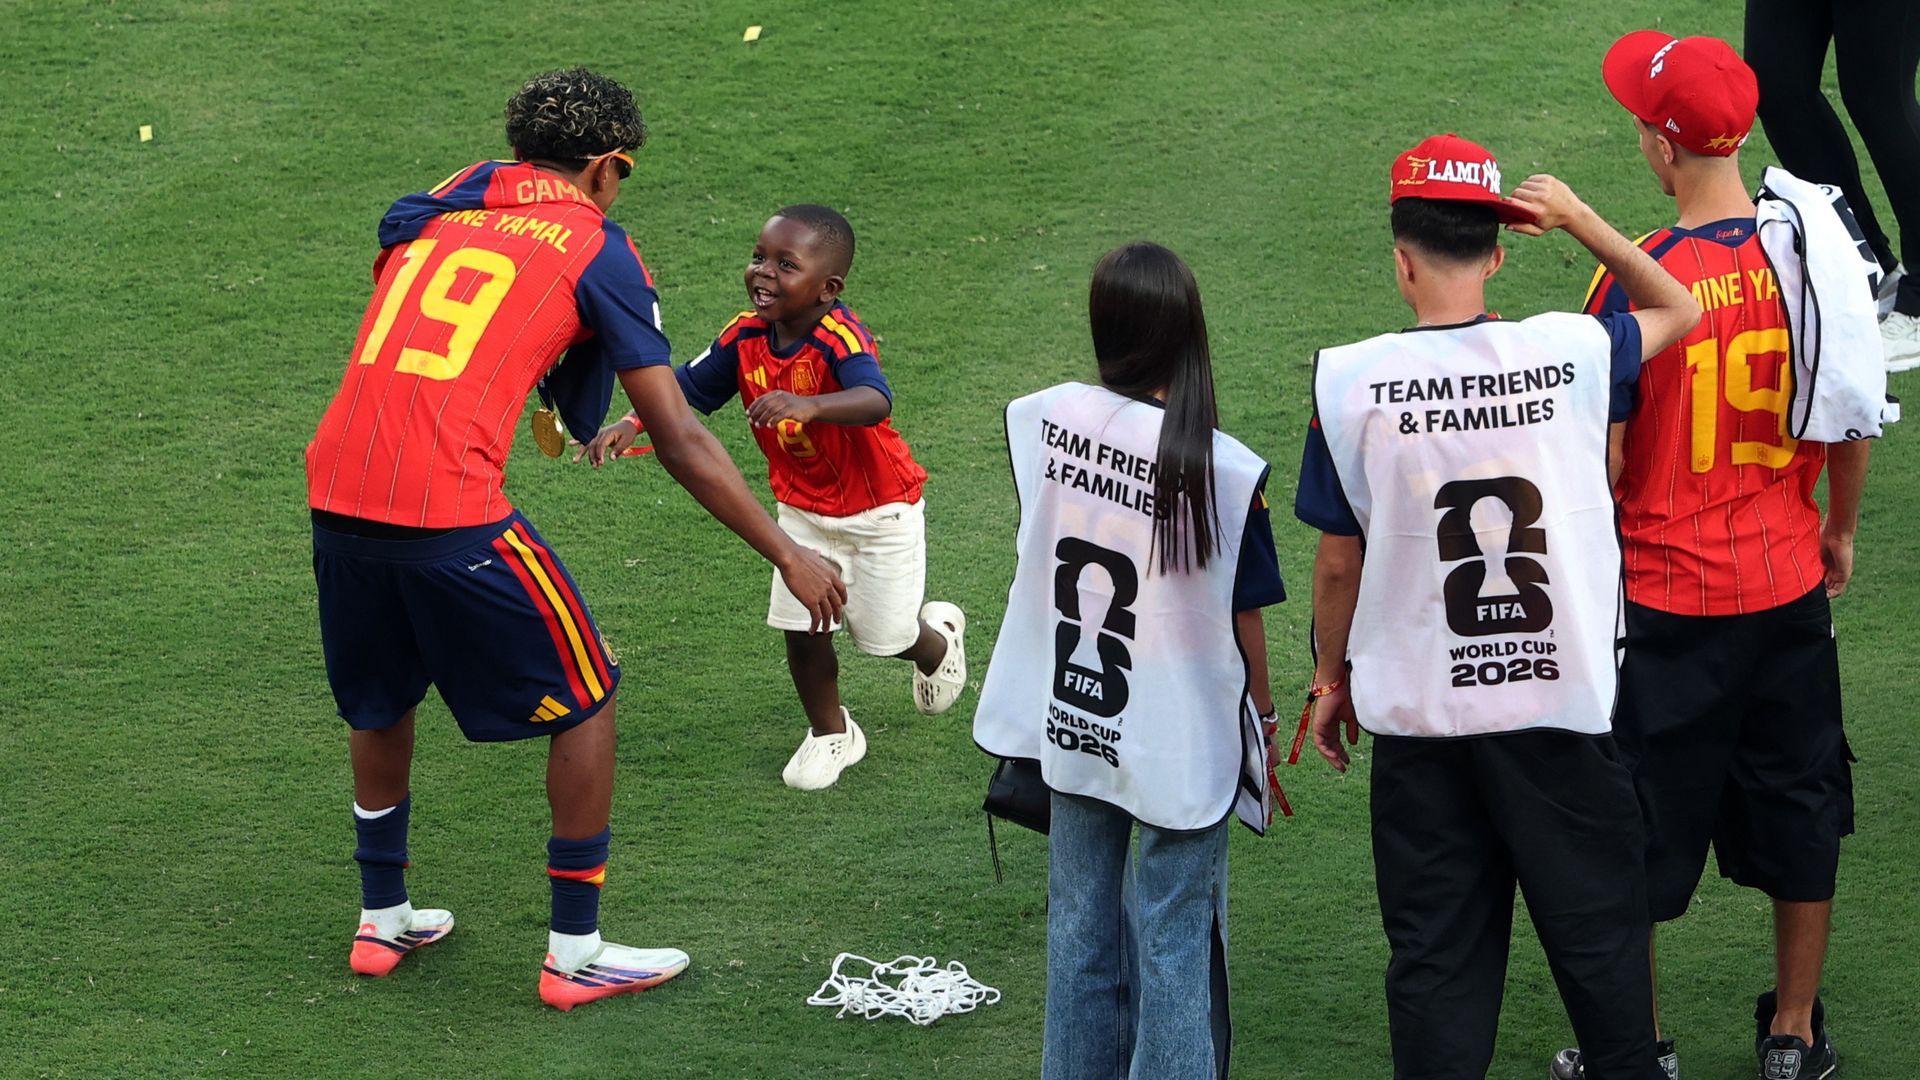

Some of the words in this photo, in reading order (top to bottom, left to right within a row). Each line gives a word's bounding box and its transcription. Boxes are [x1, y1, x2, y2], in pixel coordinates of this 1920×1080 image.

[494, 214, 573, 254] YAMAL
[358, 239, 516, 381] 19
[1370, 377, 1454, 404] TEAM
[1461, 362, 1575, 398] FRIENDS
[1686, 328, 1797, 474] 19
[1399, 411, 1420, 434] &
[1425, 398, 1554, 432] FAMILIES
[1041, 418, 1091, 461] TEAM
[1045, 457, 1057, 481] &
[1476, 602, 1527, 621] FIFA
[1449, 641, 1518, 661] WORLD
[1521, 640, 1557, 655] CUP
[1064, 670, 1103, 700] FIFA
[1450, 658, 1560, 687] 2026
[1047, 717, 1120, 768] 2026
[1091, 723, 1121, 743] CUP
